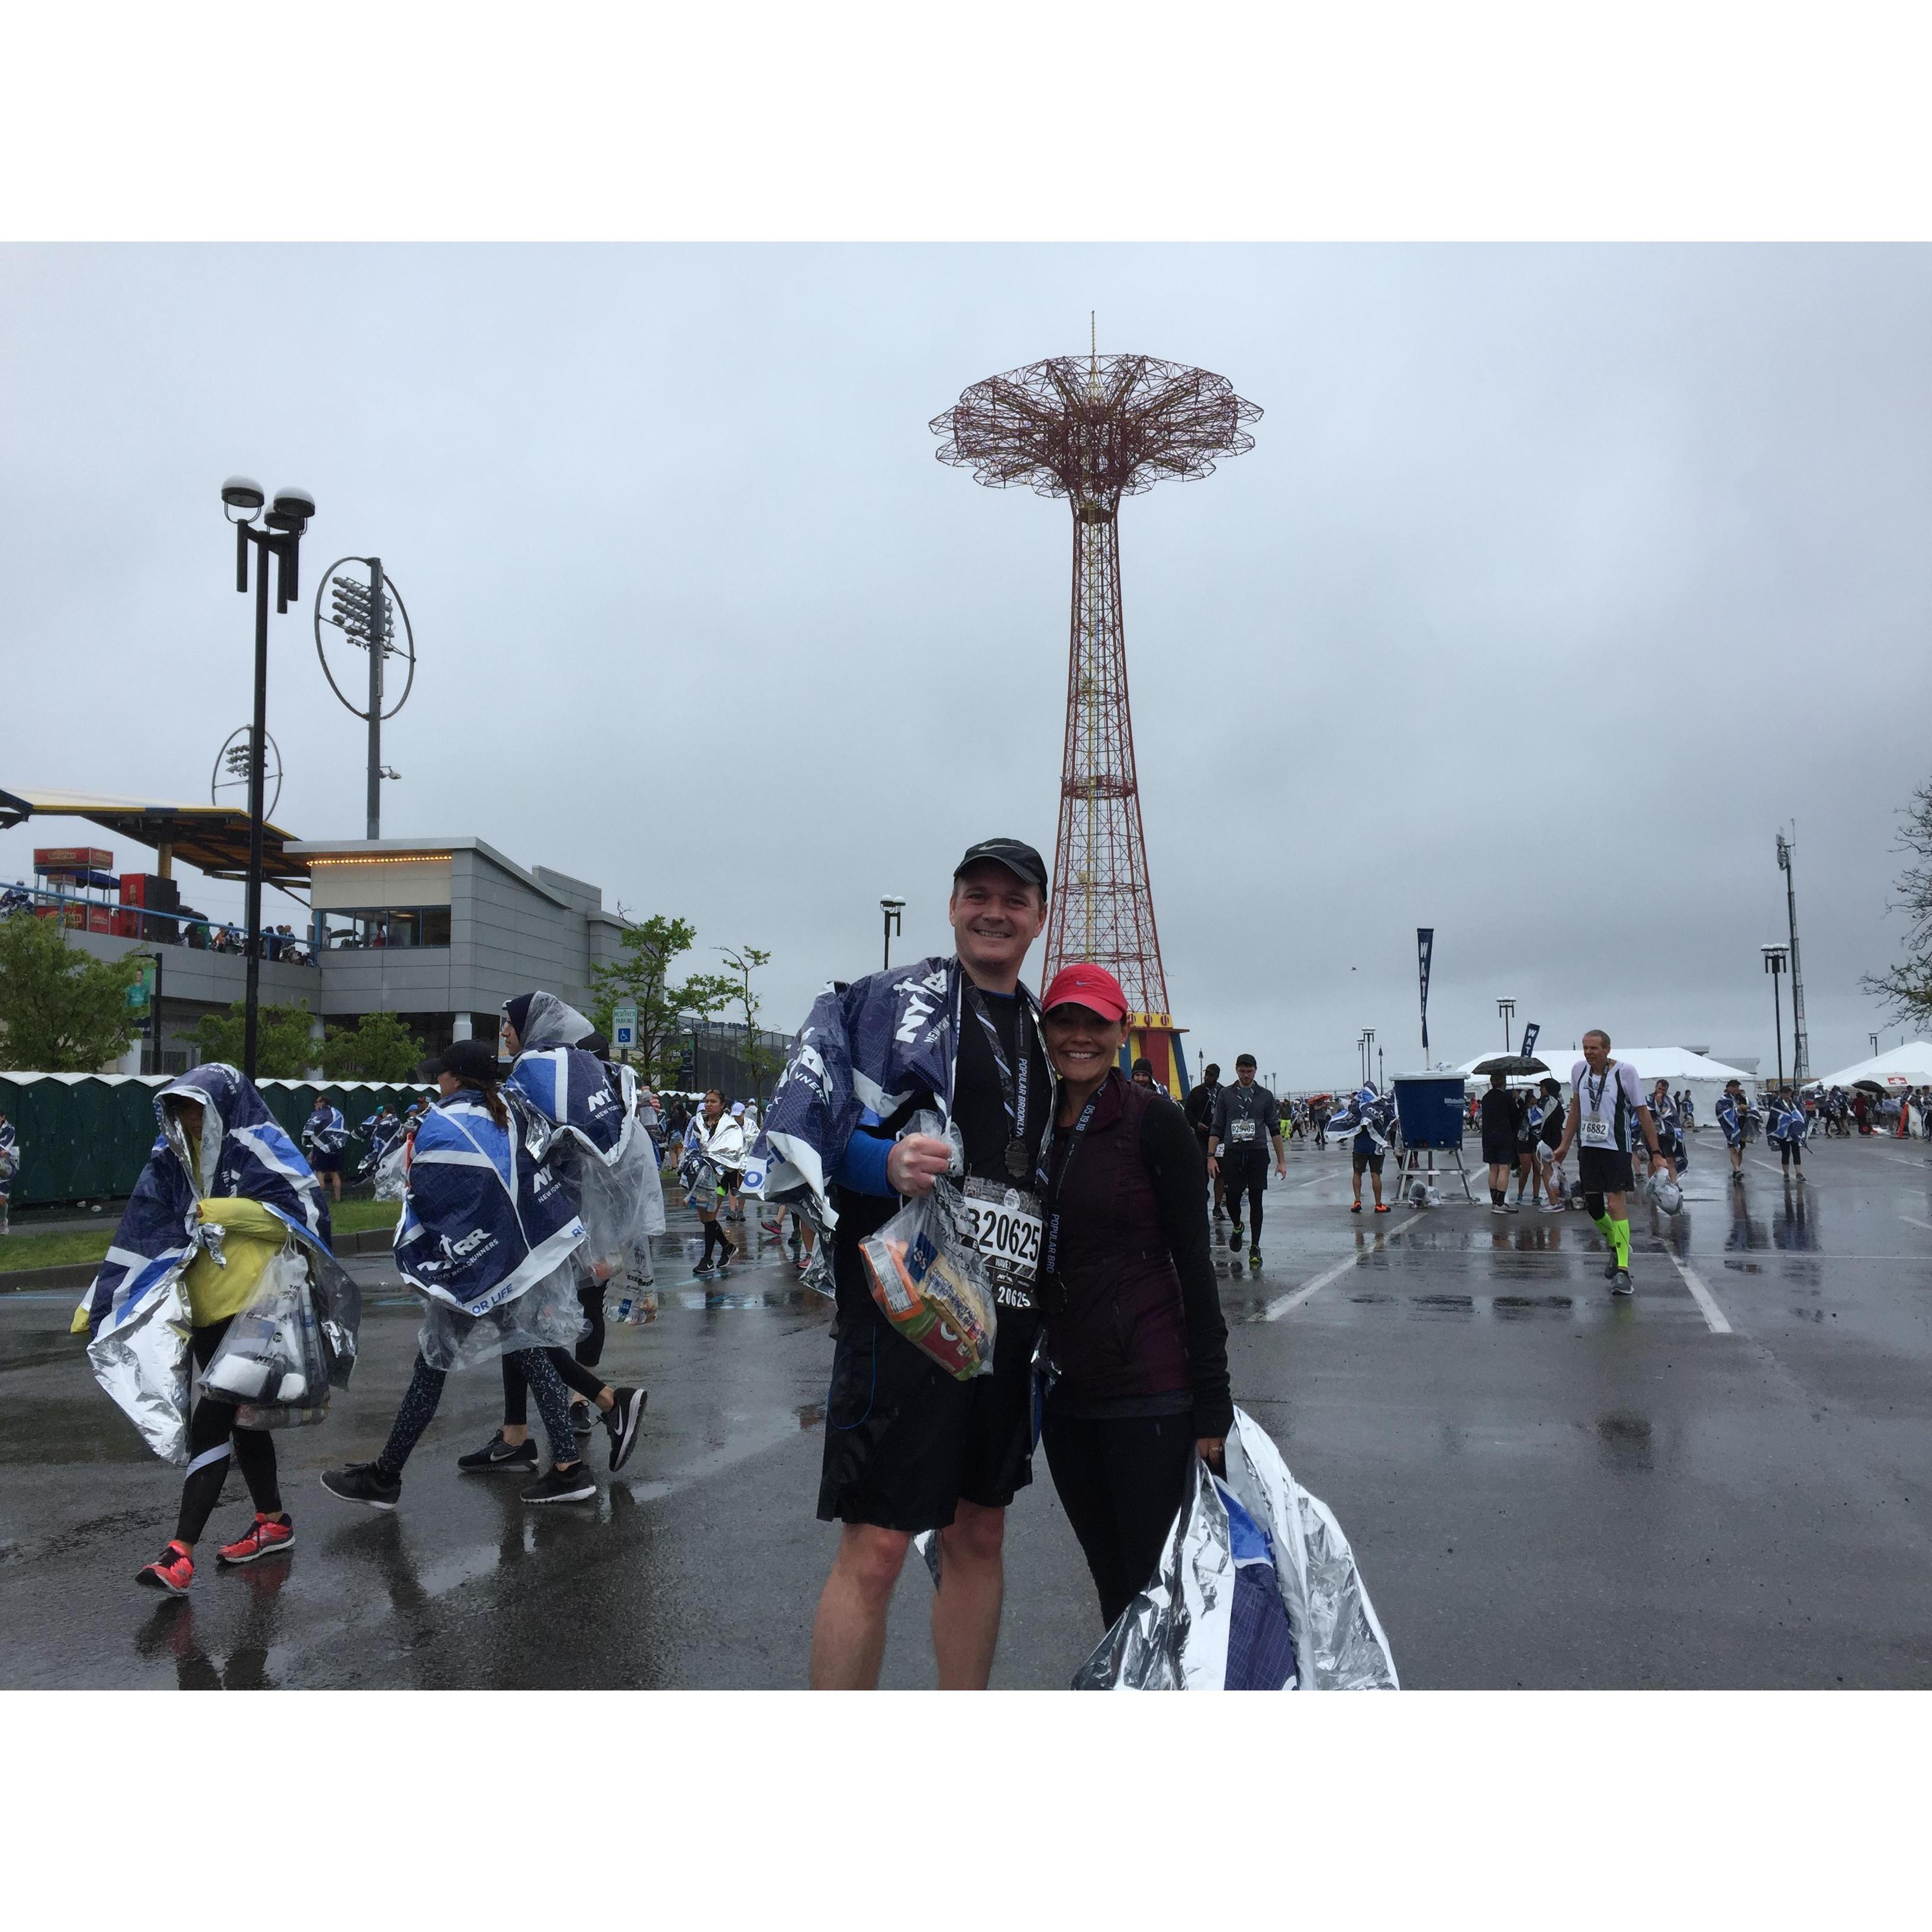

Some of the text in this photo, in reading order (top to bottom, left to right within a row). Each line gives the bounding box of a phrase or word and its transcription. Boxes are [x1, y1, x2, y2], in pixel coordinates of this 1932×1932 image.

[1524, 1028, 1537, 1058] WAT
[1017, 1058, 1028, 1094] POPULAR
[594, 1107, 609, 1120] NEW
[1015, 1094, 1026, 1138] BROOKLYN
[1076, 1105, 1096, 1132] 05.19.18
[1586, 1123, 1606, 1135] 6882
[1047, 1213, 1060, 1256] POPULAR
[470, 1238, 499, 1264] RUNNERS
[490, 1283, 514, 1305] LIFE
[997, 1286, 1031, 1308] 20625
